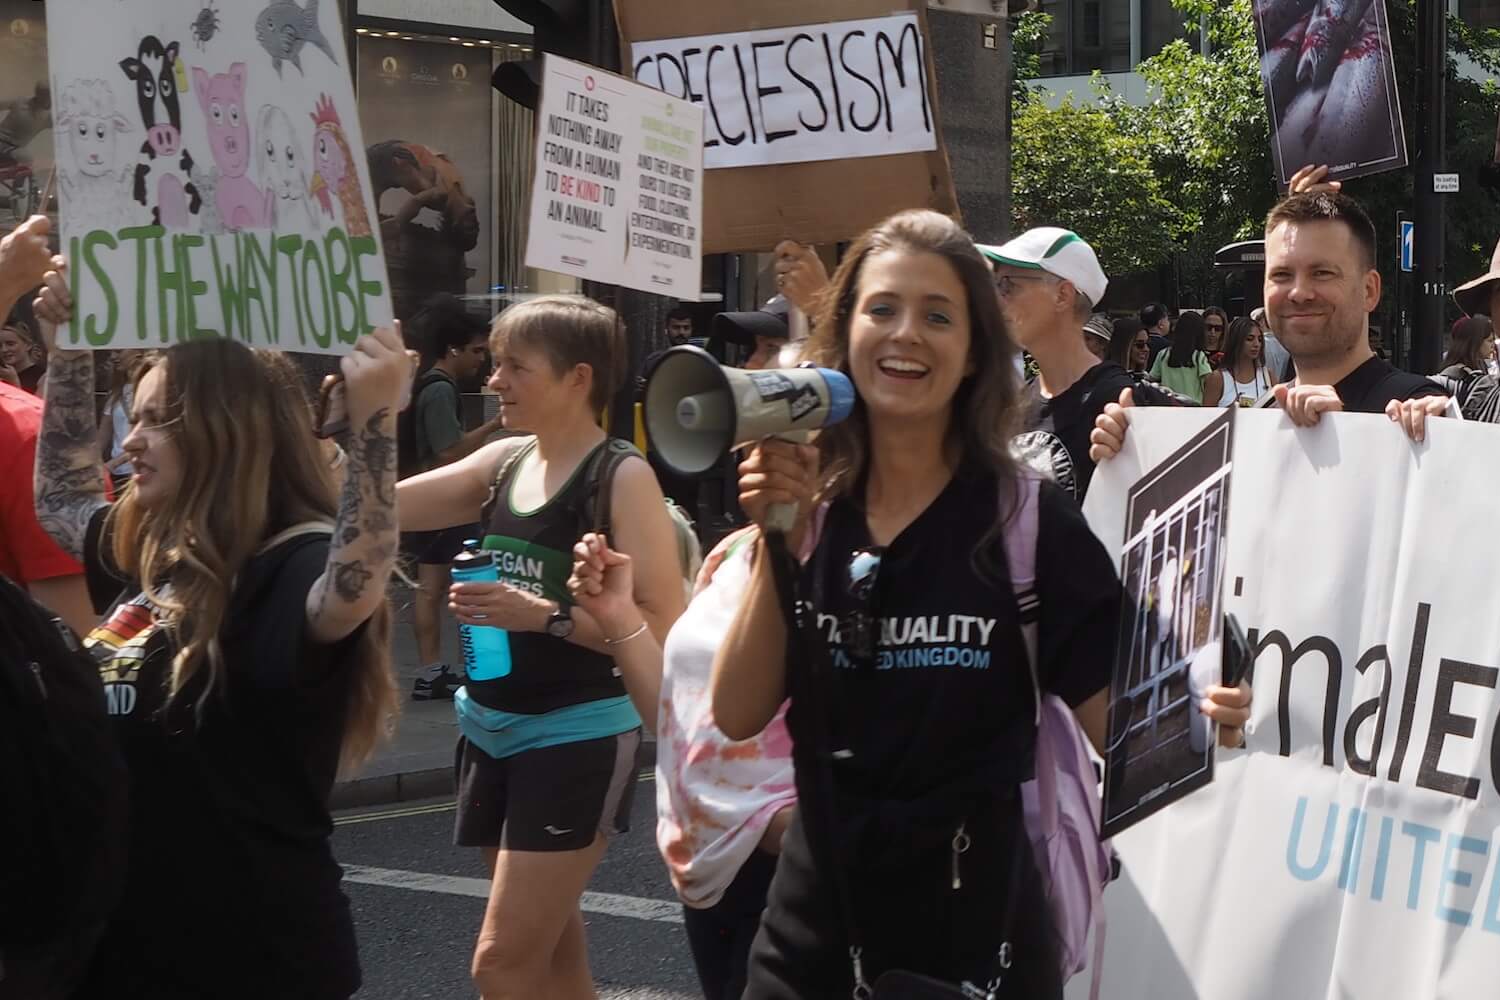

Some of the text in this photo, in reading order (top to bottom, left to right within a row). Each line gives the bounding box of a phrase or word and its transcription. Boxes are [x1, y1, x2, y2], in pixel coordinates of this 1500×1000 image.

[566, 91, 609, 122] IT TAKES
[548, 113, 592, 145] NOTHING
[593, 128, 622, 154] AWAY
[544, 141, 621, 181] FROM A HUMAN
[546, 169, 615, 207] TO BE KIND TO
[547, 199, 607, 232] AN ANIMAL
[70, 225, 382, 348] IS THE WAY TO BE
[487, 550, 544, 580] EGAN
[895, 646, 991, 670] KINGDOM
